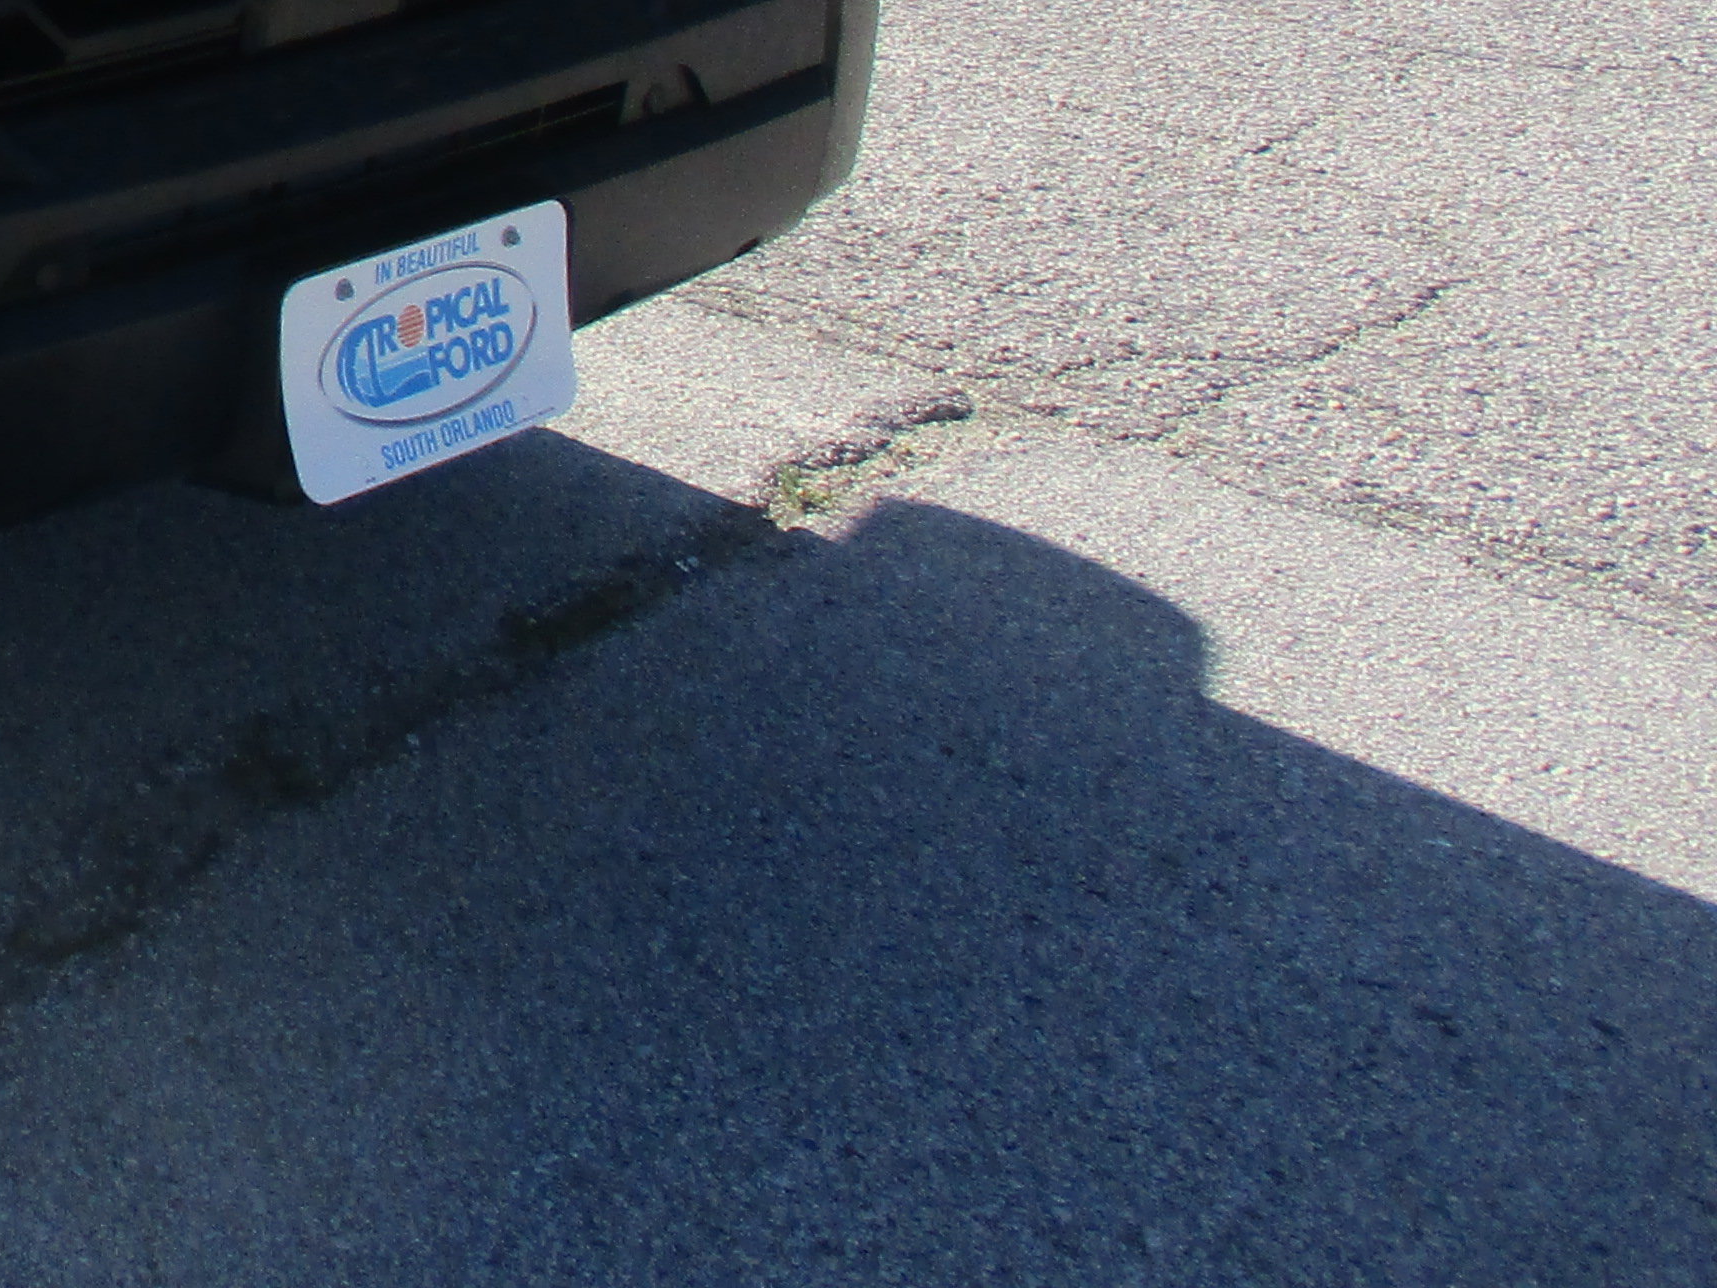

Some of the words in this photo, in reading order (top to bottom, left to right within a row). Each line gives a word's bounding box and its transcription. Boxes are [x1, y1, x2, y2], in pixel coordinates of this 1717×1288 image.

[374, 262, 392, 285] IN
[396, 231, 481, 278] BEAUTIFUL
[337, 277, 510, 387] TROPICAL
[428, 320, 514, 386] FORD
[380, 429, 439, 470] SOUTH
[439, 399, 516, 448] ORLANDO
